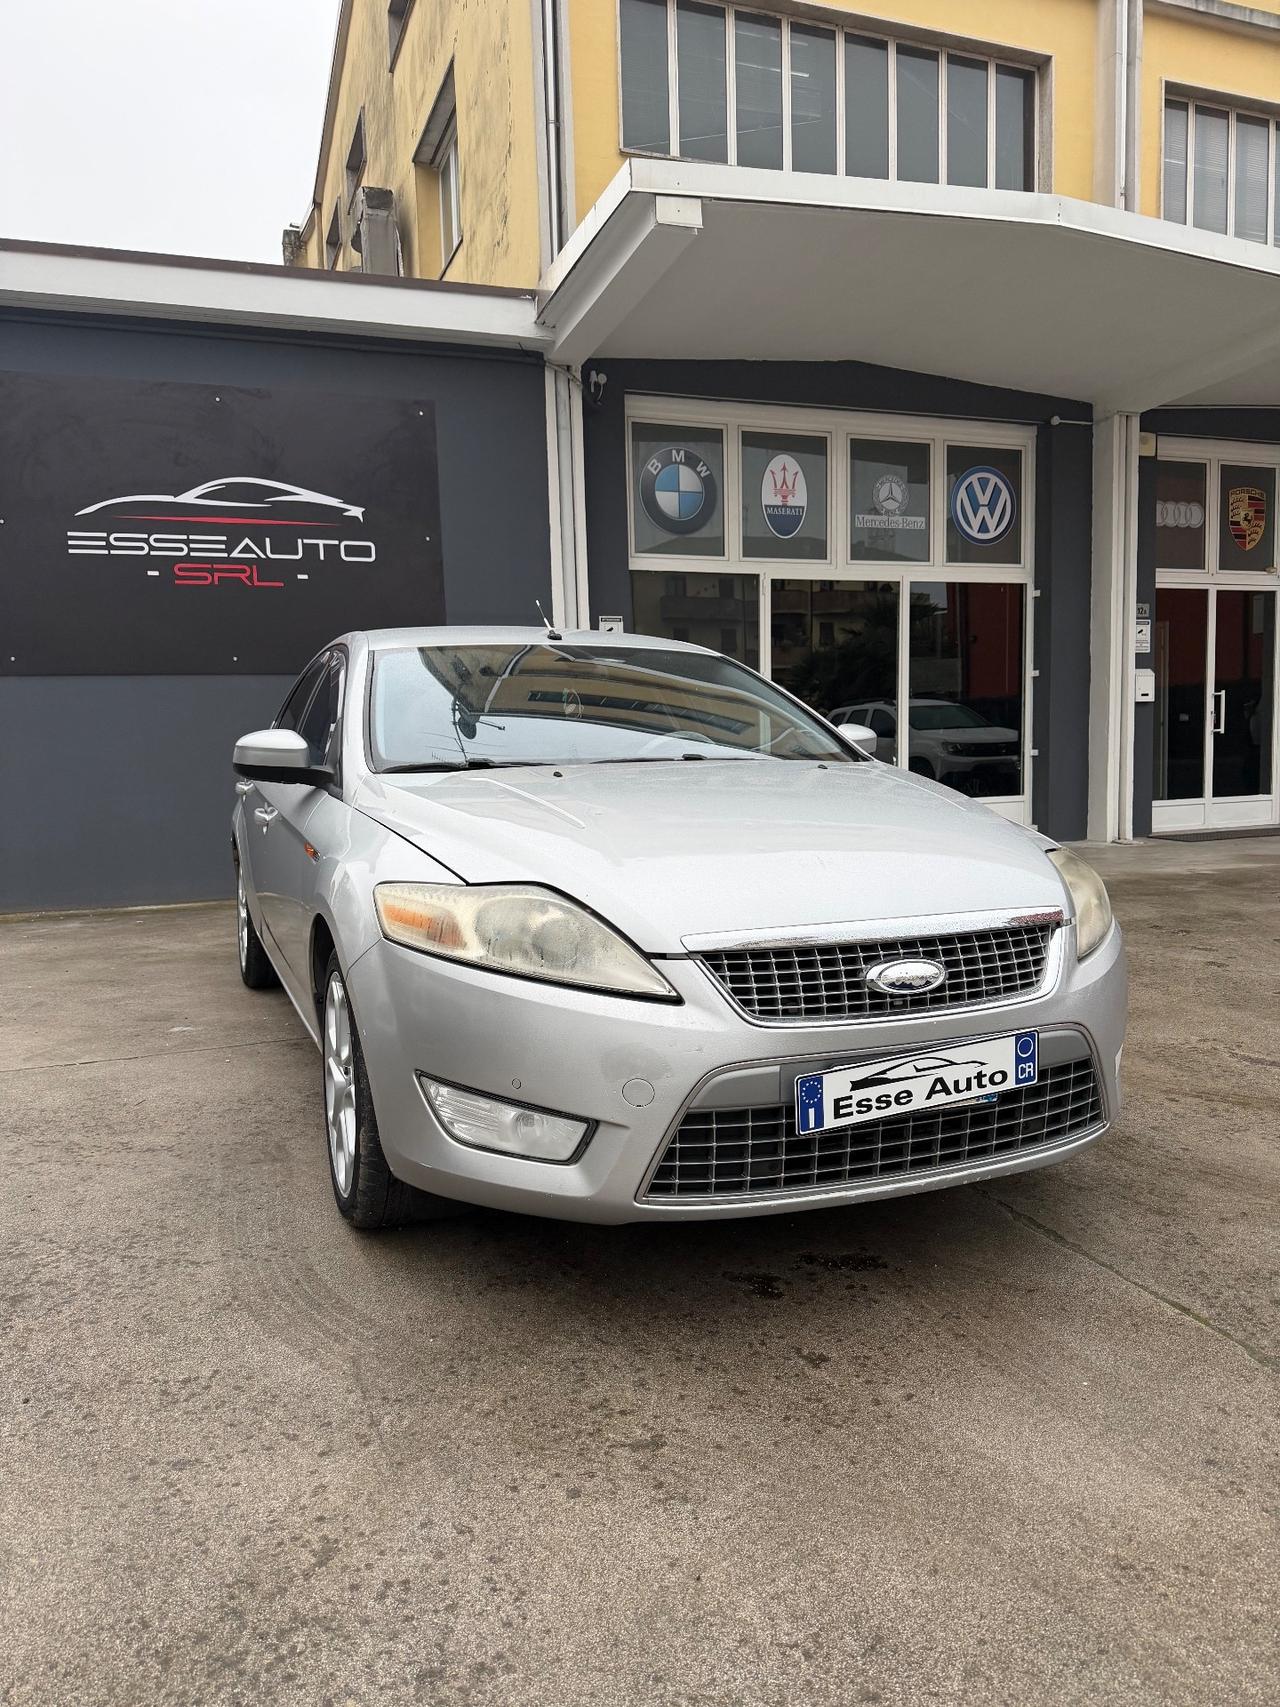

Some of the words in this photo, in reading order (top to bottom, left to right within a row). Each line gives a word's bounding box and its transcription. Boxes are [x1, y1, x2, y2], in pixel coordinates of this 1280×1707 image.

[646, 450, 711, 477] BMW
[766, 507, 803, 516] MASERATI
[856, 516, 925, 529] Mercedes-Benz
[66, 531, 376, 563] ESSEAUTO
[173, 563, 284, 587] SRL
[1018, 1062, 1034, 1079] CR
[833, 1088, 913, 1120] Esse
[925, 1069, 1008, 1101] Auto
